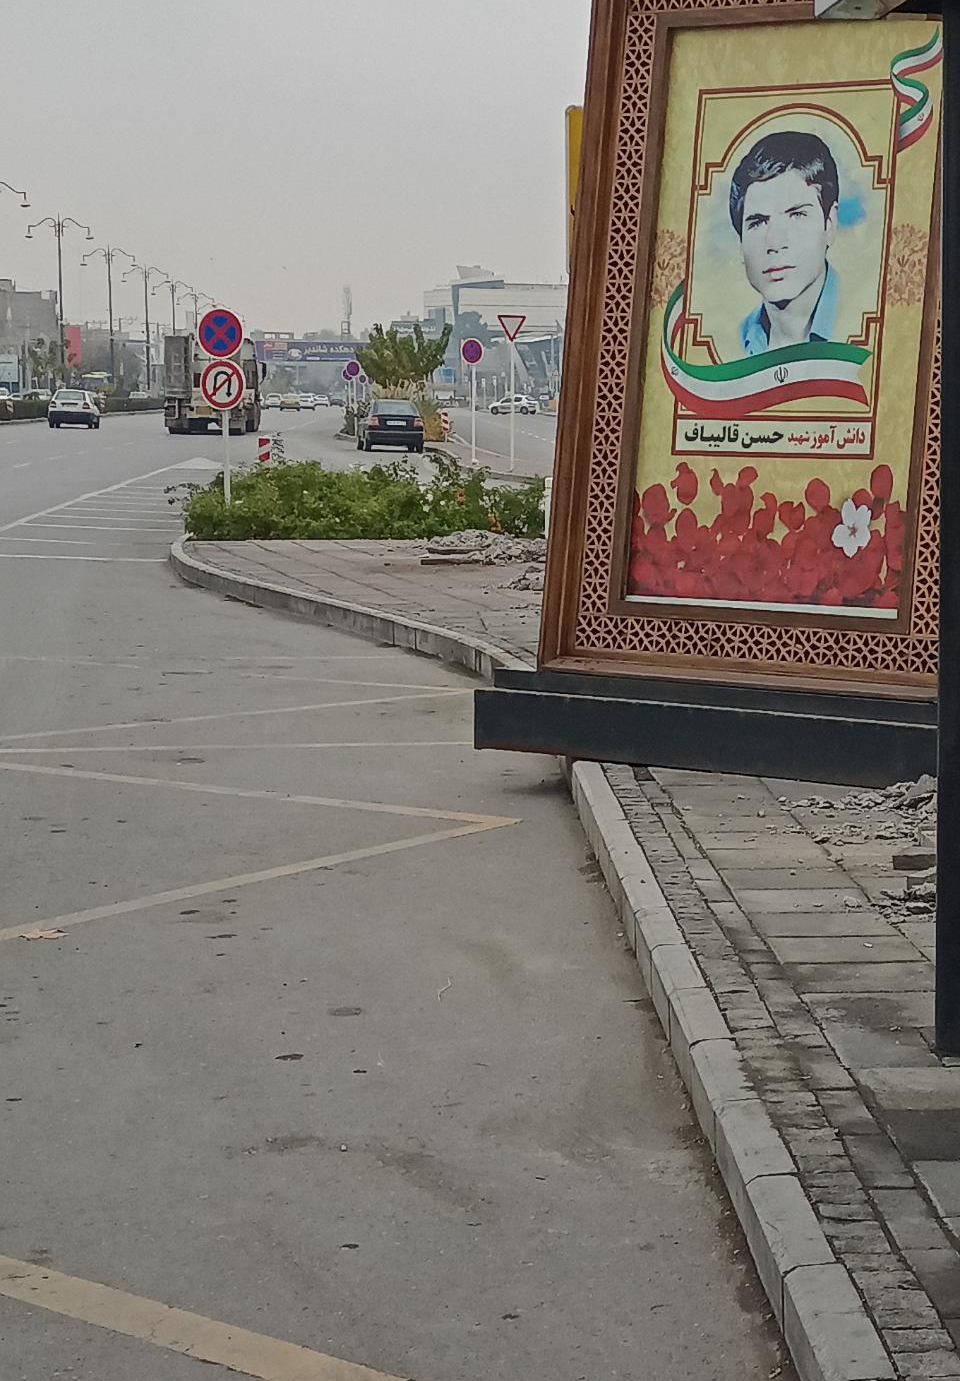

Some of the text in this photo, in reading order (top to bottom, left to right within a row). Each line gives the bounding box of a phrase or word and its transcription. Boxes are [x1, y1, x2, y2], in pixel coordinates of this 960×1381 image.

[684, 422, 866, 450] دانش آموز شهید حسن قالیباف
